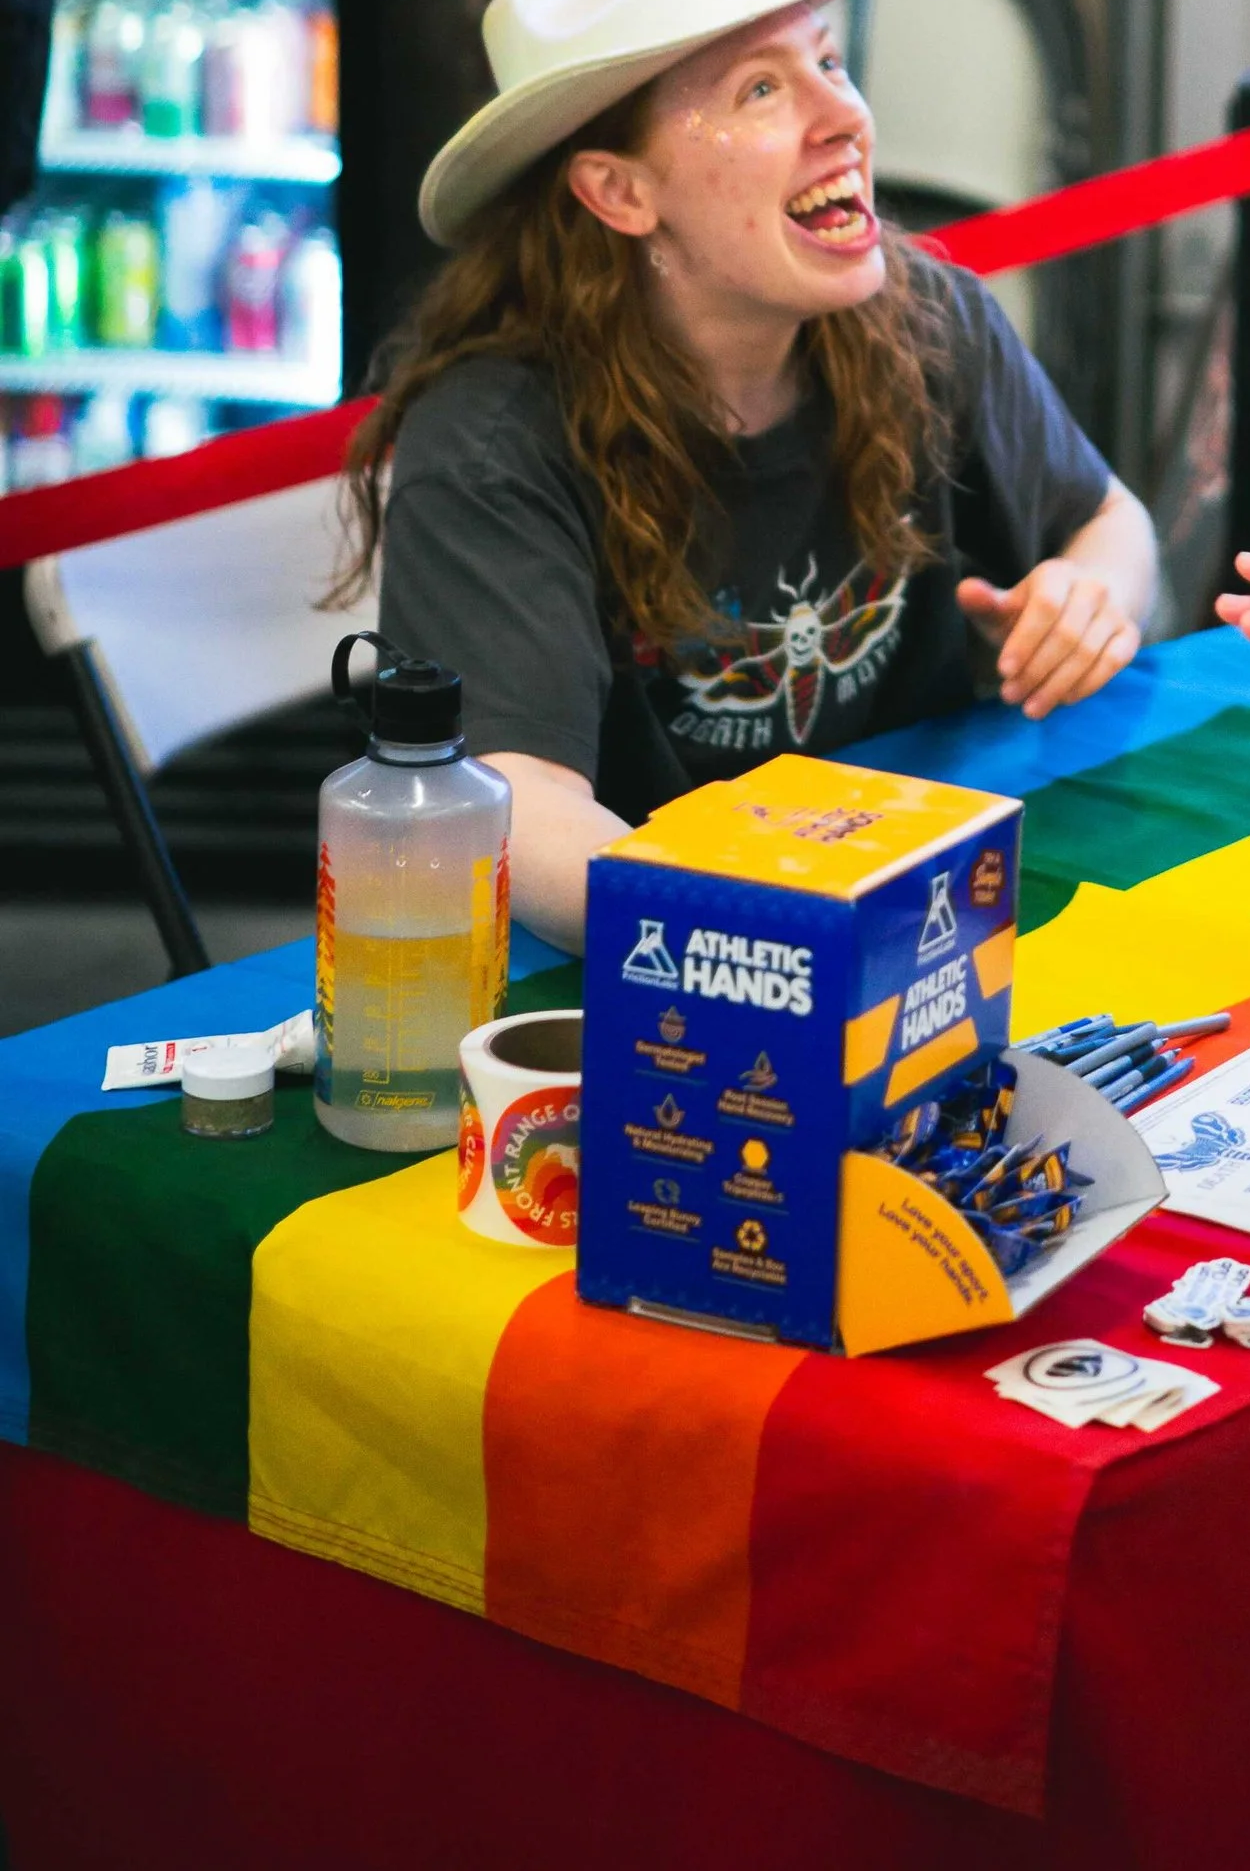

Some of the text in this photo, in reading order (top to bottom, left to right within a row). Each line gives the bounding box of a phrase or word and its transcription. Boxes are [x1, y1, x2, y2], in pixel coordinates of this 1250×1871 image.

[669, 629, 901, 750] DEATH MOTH
[685, 928, 813, 977] ATHLETIC
[682, 956, 814, 1017] HANDS
[903, 953, 969, 1014] ATHLETIC
[901, 982, 967, 1051] HANDS
[504, 1104, 558, 1228] FRONT RANGE
[878, 1200, 911, 1232] Love
[910, 1229, 941, 1258] your
[901, 1196, 932, 1229] Love
[932, 1228, 960, 1258] your
